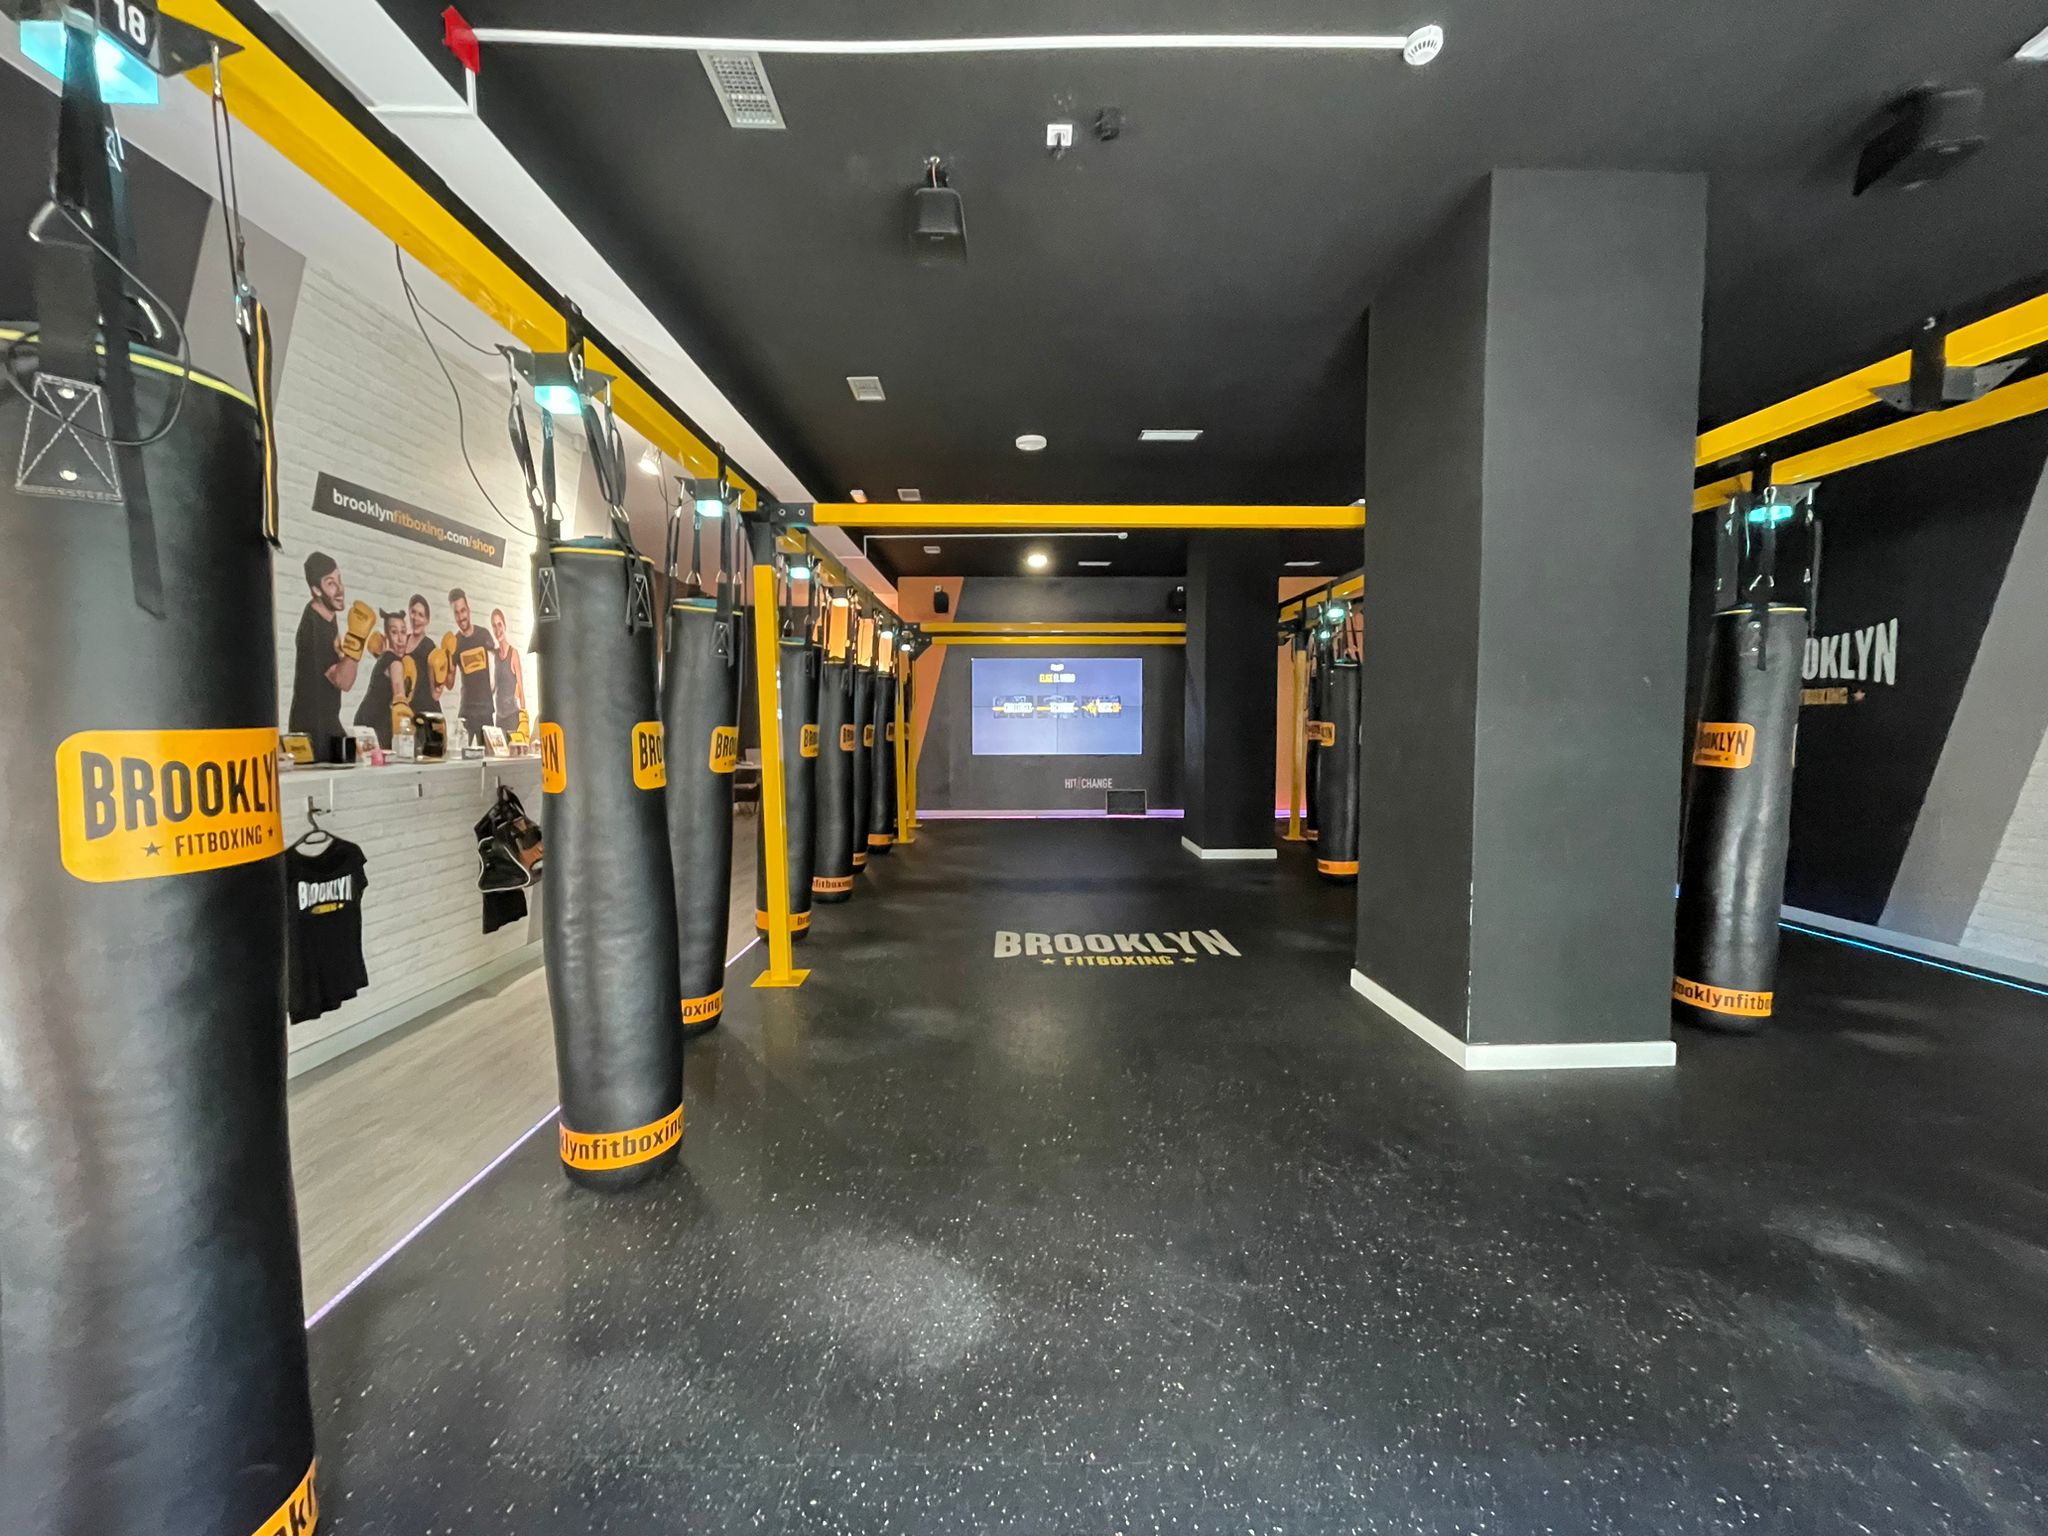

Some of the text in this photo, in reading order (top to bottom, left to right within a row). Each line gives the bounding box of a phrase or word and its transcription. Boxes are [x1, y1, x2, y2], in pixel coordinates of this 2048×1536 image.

[113, 0, 147, 46] 18
[333, 487, 496, 557] brooklynfitboxing.com/shop
[174, 825, 263, 857] FITBOXING
[993, 929, 1242, 958] BROOKLYN
[1064, 955, 1175, 967] FITBOXING
